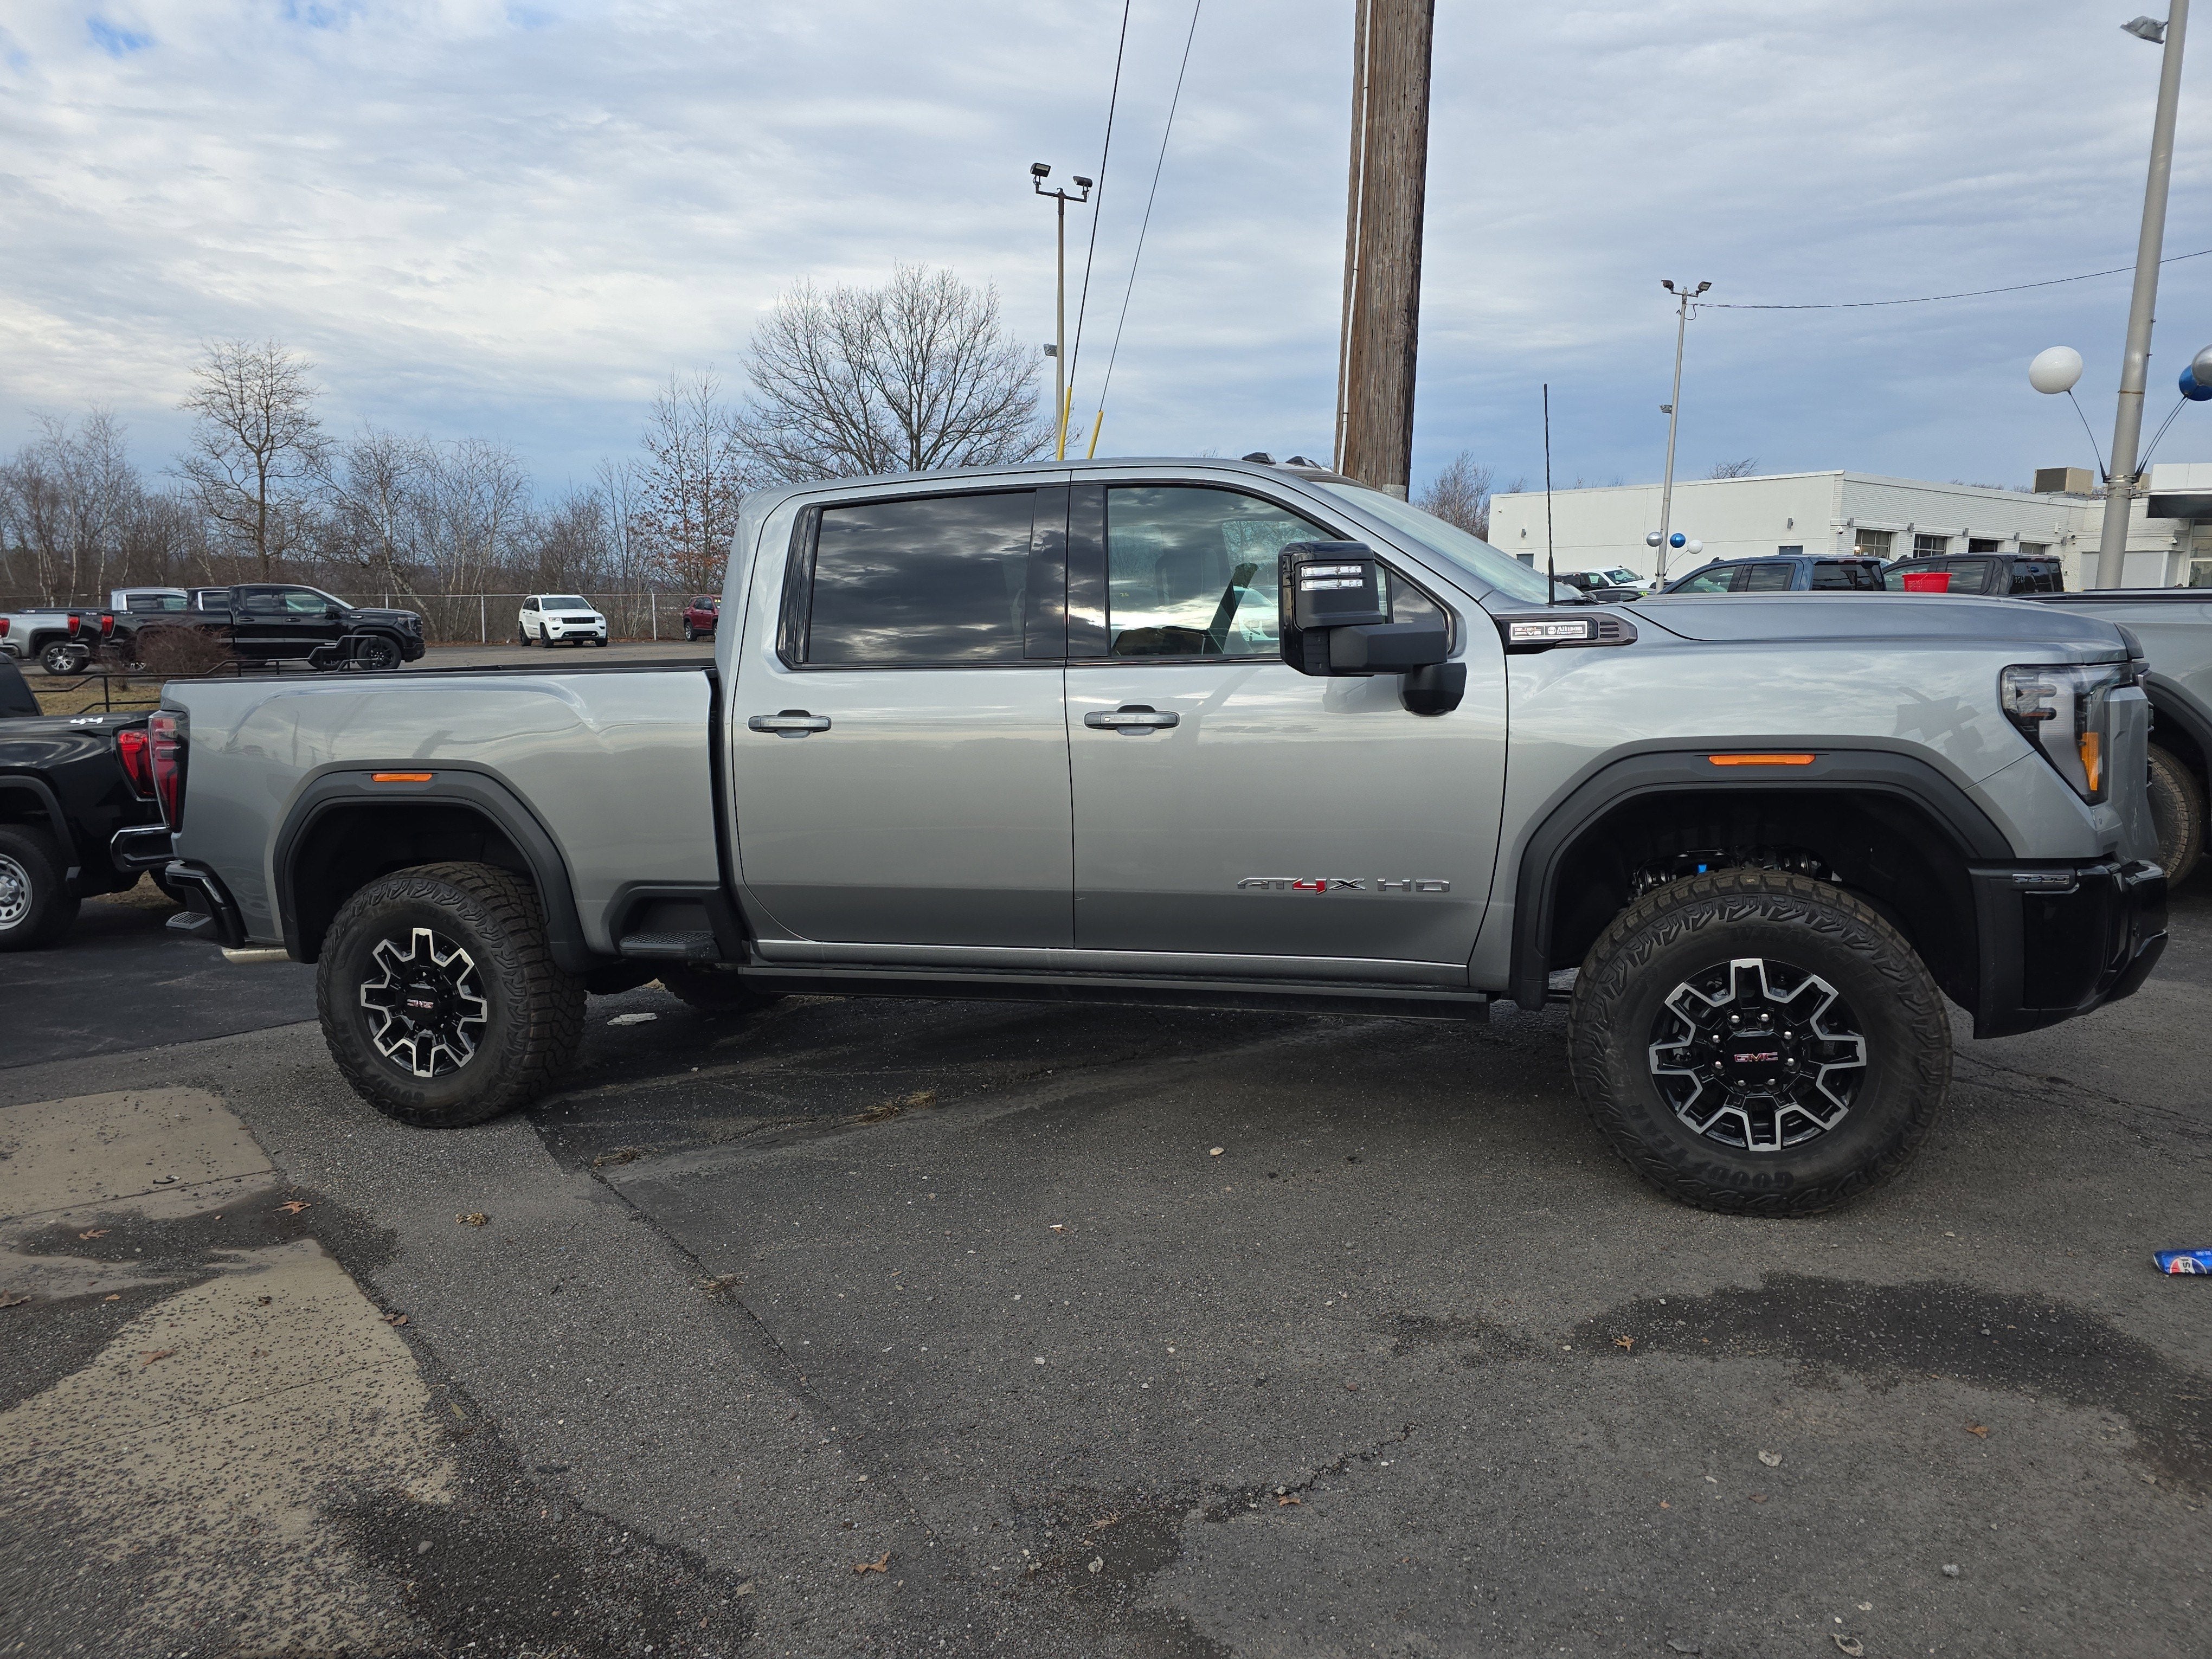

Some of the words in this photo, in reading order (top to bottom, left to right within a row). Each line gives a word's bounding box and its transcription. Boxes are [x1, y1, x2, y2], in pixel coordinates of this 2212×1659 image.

[1237, 877, 1366, 895] AT4X
[1377, 878, 1450, 892] HD
[1734, 1052, 1778, 1063] GMC
